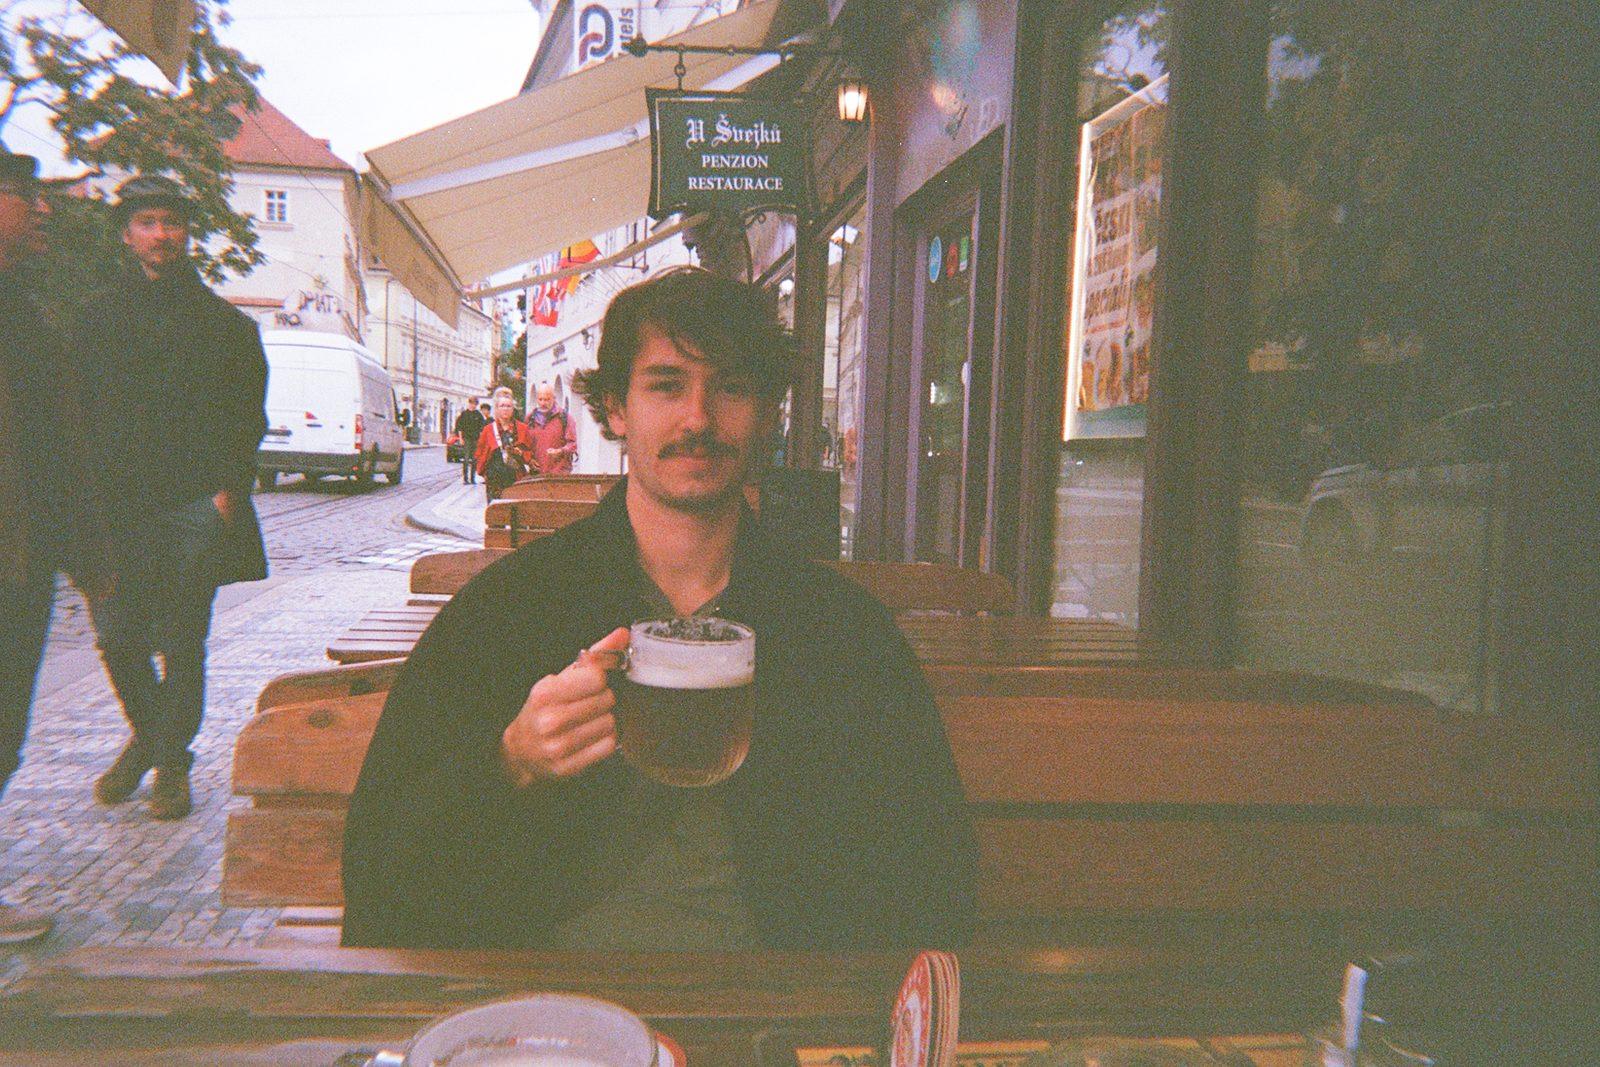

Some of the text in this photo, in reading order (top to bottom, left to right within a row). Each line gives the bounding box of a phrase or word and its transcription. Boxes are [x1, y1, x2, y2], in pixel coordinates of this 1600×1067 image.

[686, 113, 781, 149] U Švejků
[702, 155, 768, 168] PENZION
[688, 177, 783, 190] RESTAURACE
